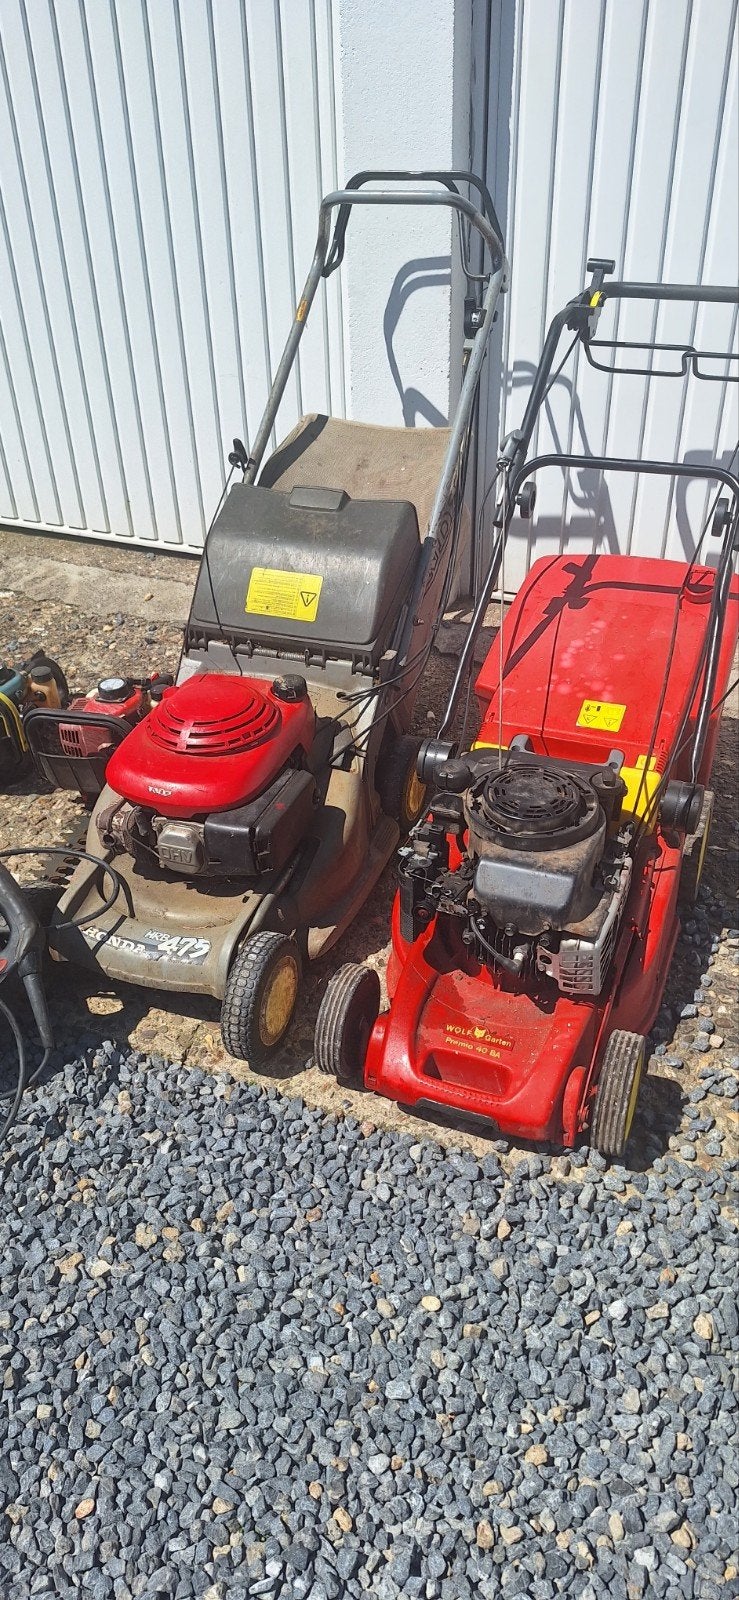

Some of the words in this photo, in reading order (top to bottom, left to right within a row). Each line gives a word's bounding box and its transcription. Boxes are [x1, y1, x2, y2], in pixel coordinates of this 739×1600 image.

[83, 926, 146, 955] HONDA
[145, 930, 171, 943] HRB
[157, 937, 211, 959] 475
[446, 1024, 473, 1037] WOLF
[484, 1035, 512, 1047] Garten
[445, 1037, 474, 1050] Premio
[475, 1046, 488, 1054] 40
[489, 1050, 501, 1059] BA
